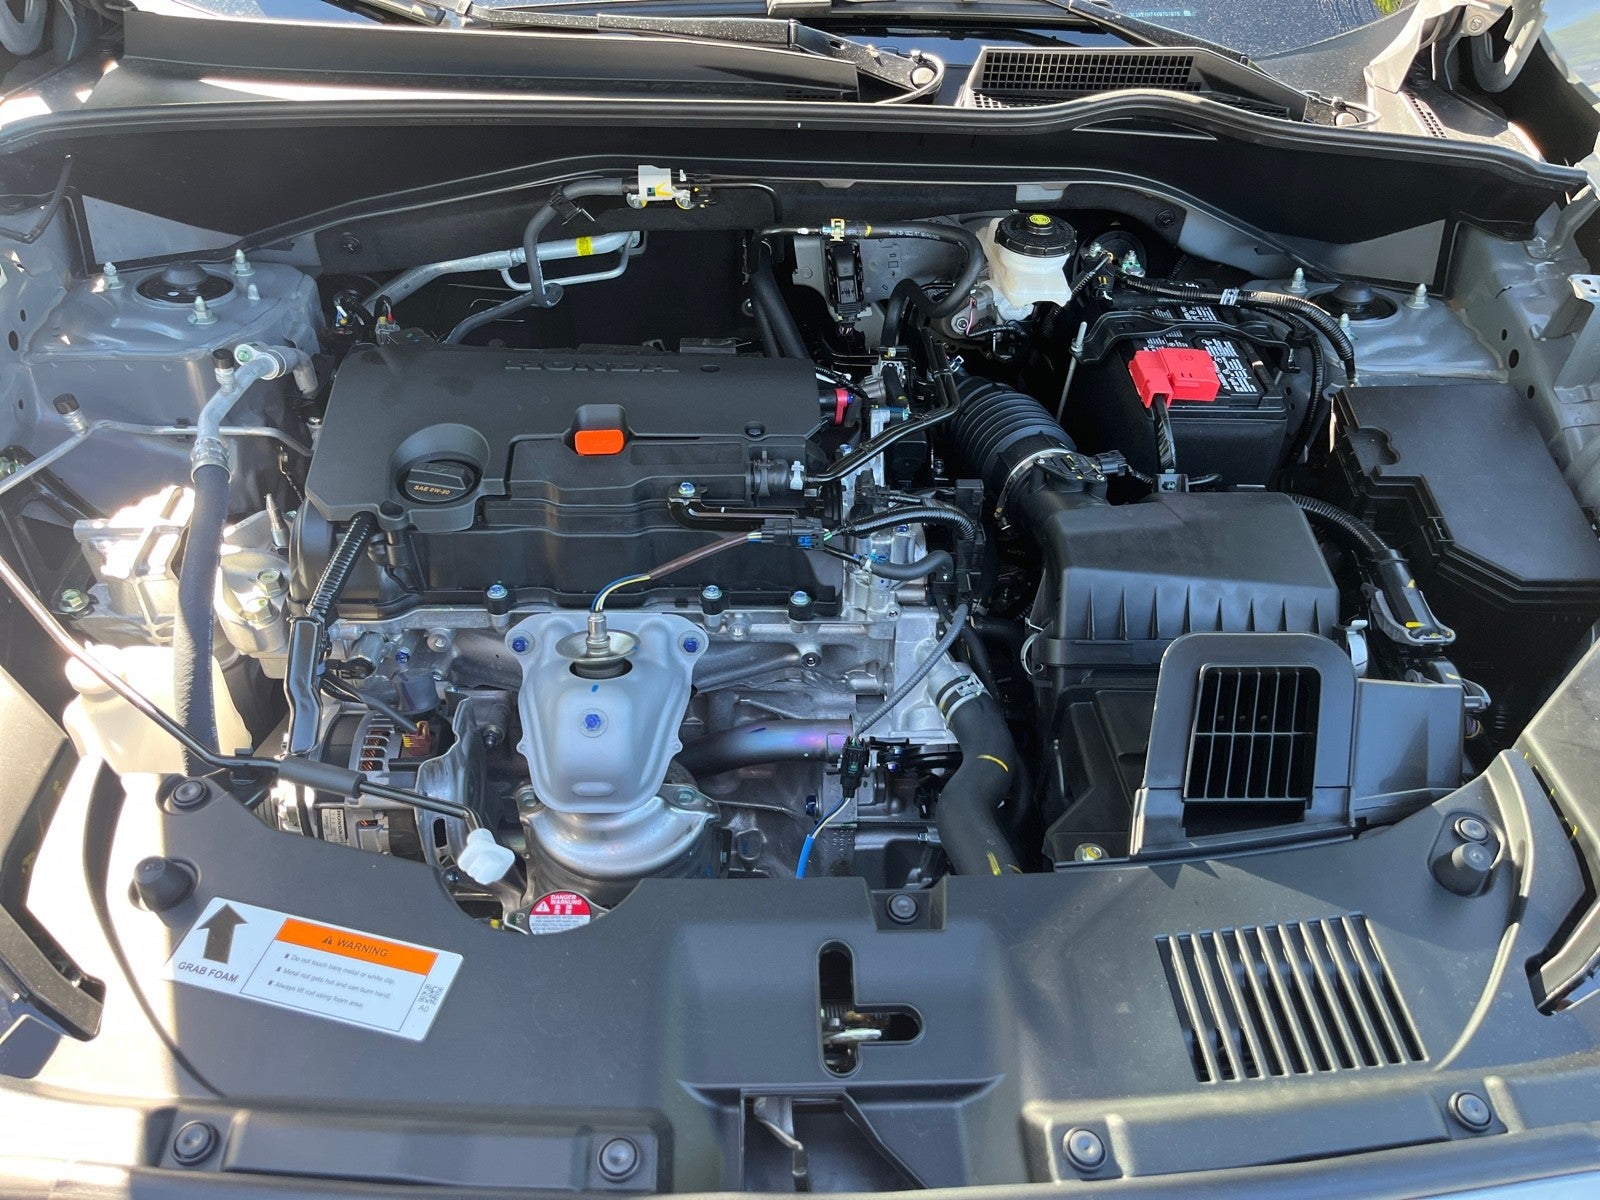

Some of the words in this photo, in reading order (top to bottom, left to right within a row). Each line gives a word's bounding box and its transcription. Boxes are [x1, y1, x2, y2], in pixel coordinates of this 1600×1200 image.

[337, 938, 389, 957] WARNING
[178, 961, 208, 975] GRAB
[207, 968, 239, 982] FOAM
[290, 954, 300, 962] Do
[311, 959, 328, 968] touch
[328, 963, 342, 972] bare
[342, 967, 359, 976] metal
[367, 973, 383, 981] white
[275, 981, 295, 992] Always
[296, 986, 304, 994] lift
[304, 988, 315, 996] rod
[315, 992, 332, 1001] using
[333, 995, 348, 1004] foam
[282, 967, 300, 977] Metal
[311, 974, 324, 983] gets
[324, 977, 335, 985] hot
[359, 986, 374, 995] burn
